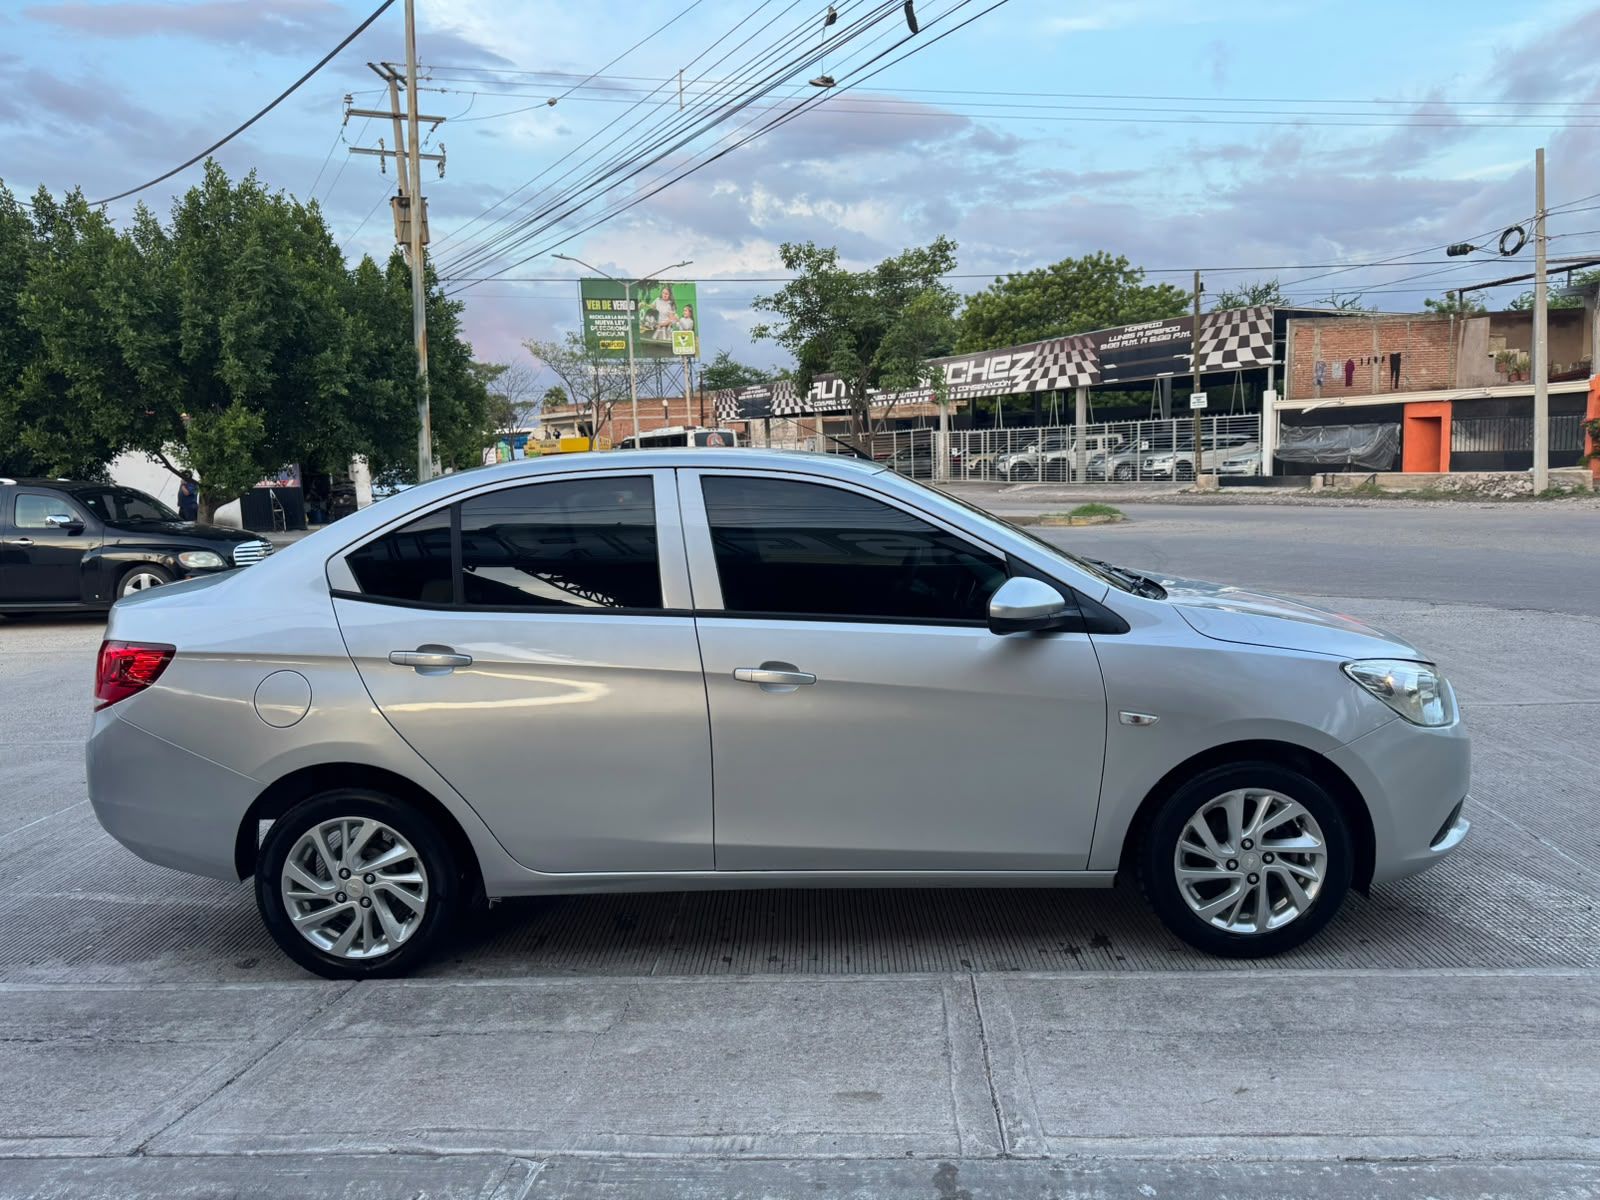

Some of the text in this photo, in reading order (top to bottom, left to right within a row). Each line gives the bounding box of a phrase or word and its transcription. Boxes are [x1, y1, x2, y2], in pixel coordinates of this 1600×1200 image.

[586, 300, 601, 310] VER
[601, 300, 612, 310] DE
[1125, 322, 1163, 332] HORARIO
[1109, 332, 1136, 342] LUNES
